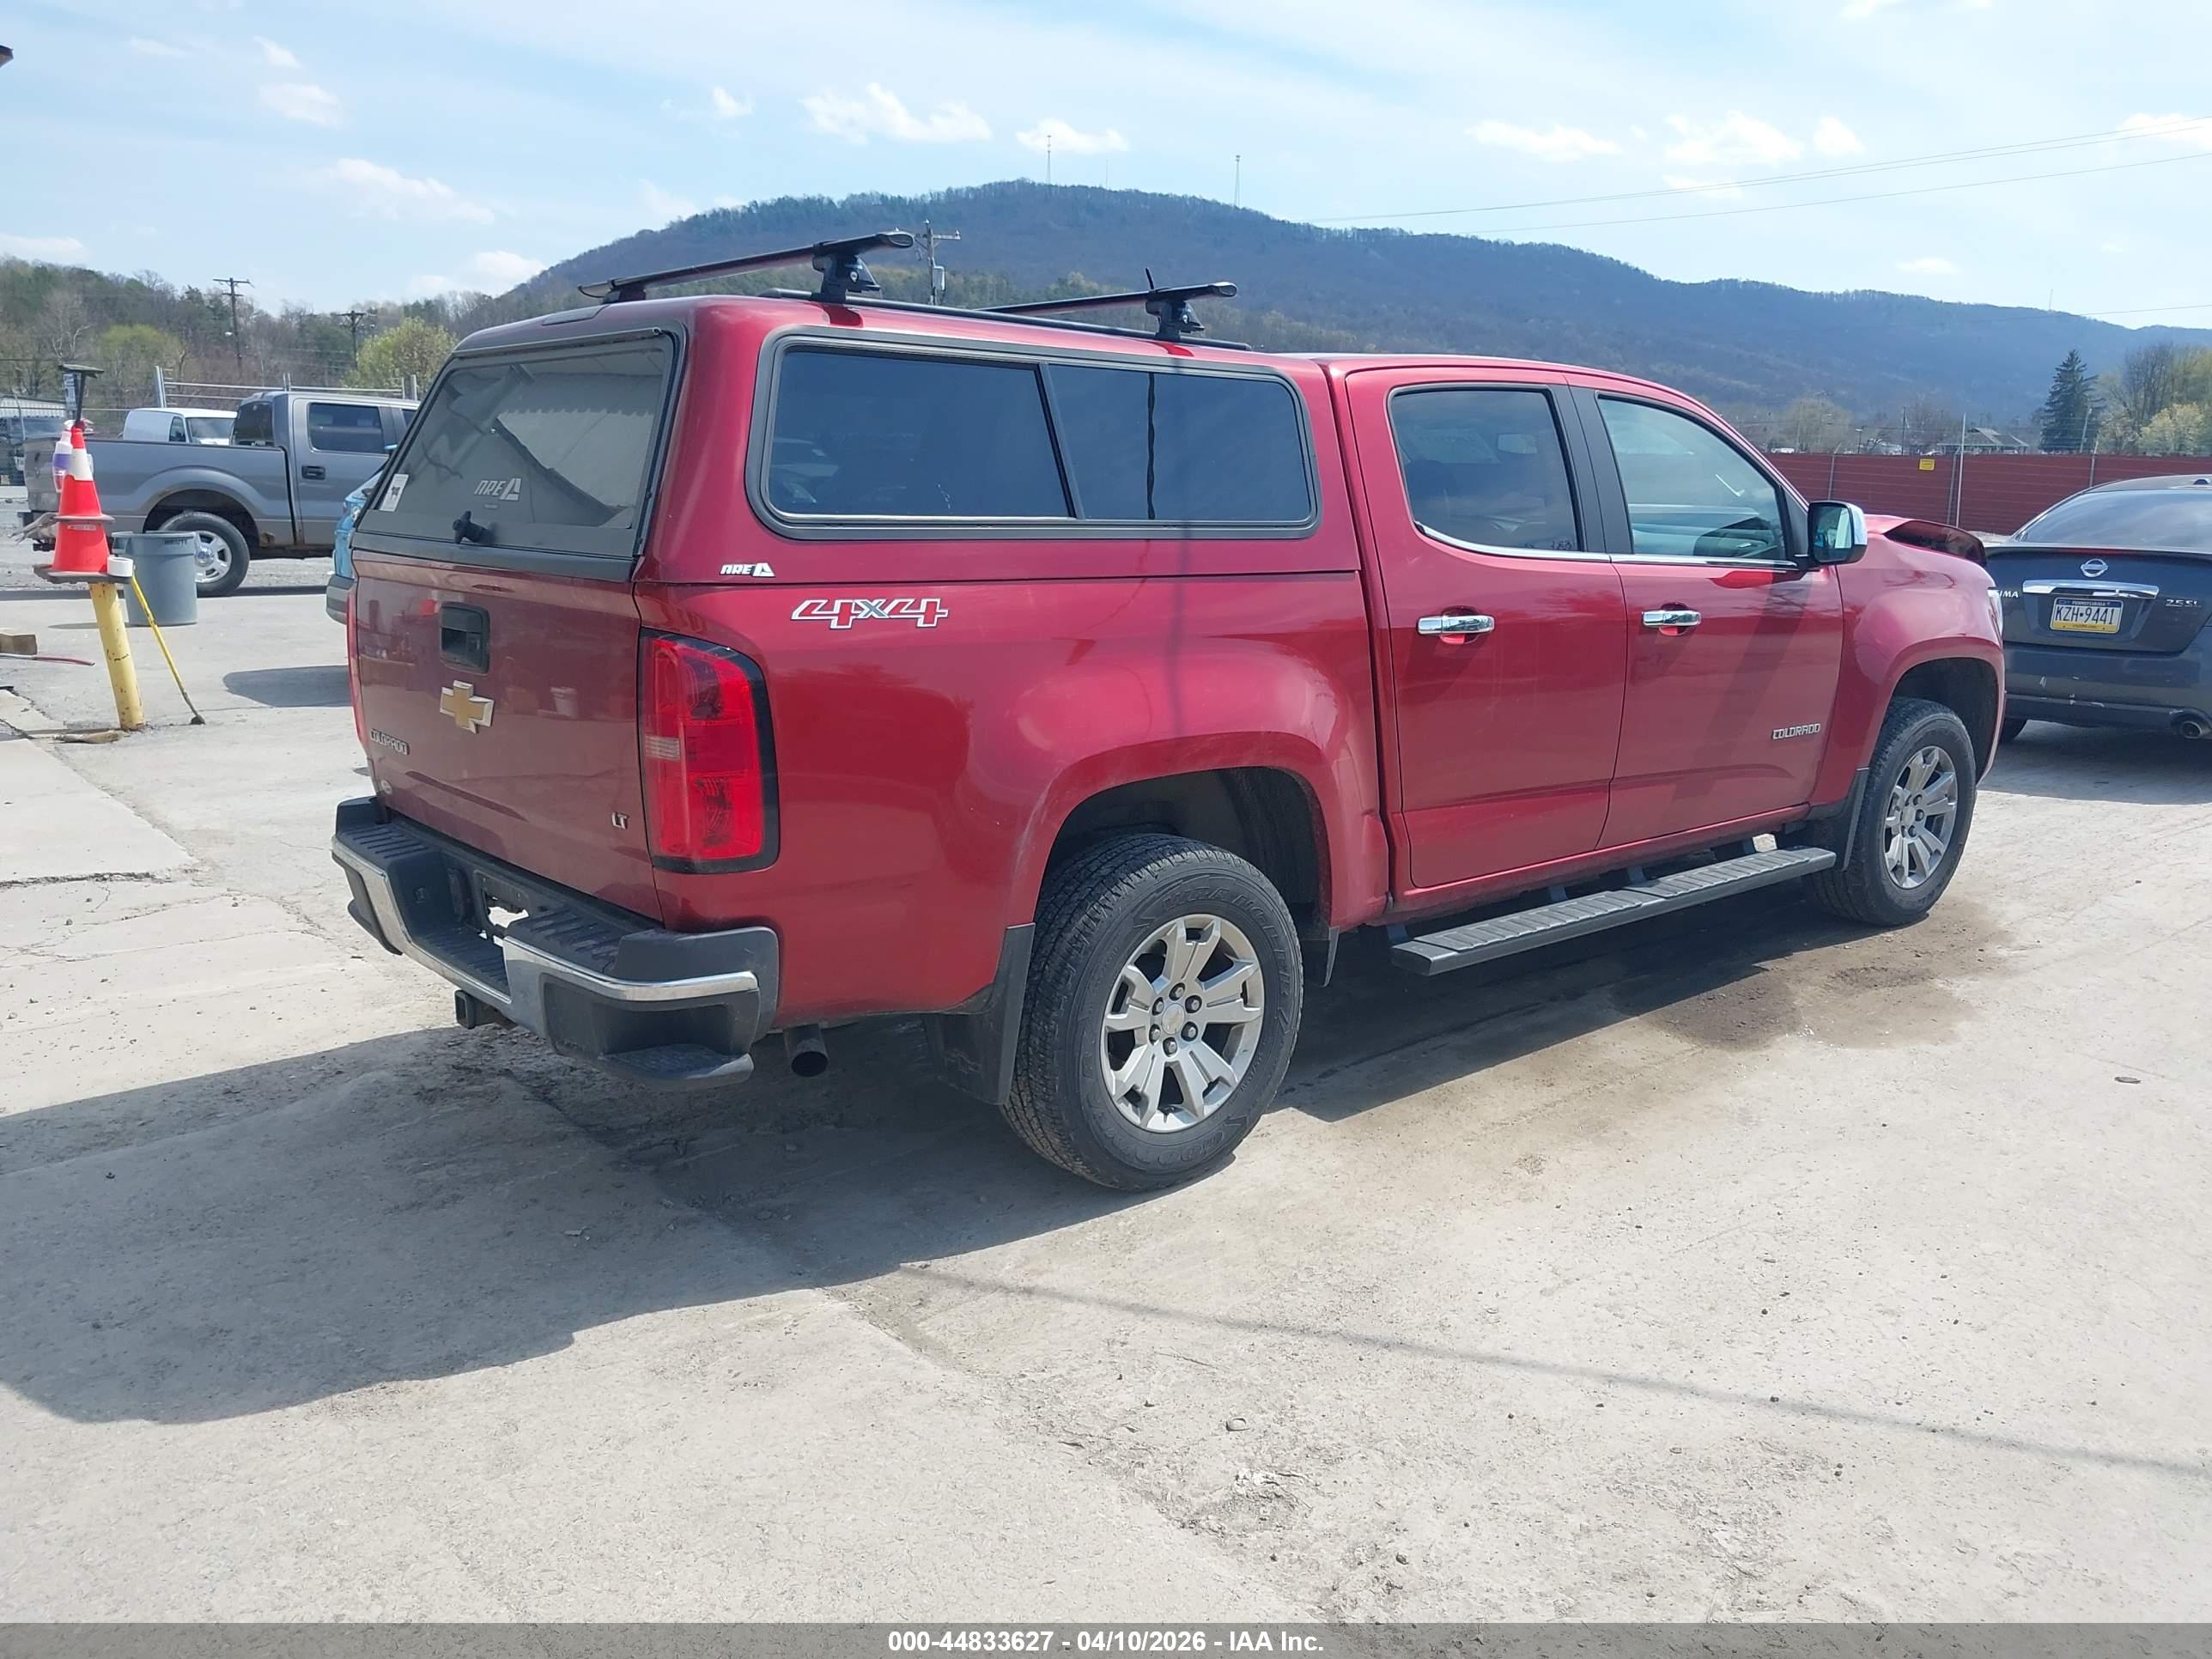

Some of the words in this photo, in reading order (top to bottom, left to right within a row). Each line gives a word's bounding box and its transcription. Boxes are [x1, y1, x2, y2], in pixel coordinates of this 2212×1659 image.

[1998, 589, 2019, 599] IMA
[1771, 722, 1821, 739] COLORADO
[611, 811, 628, 830] LT
